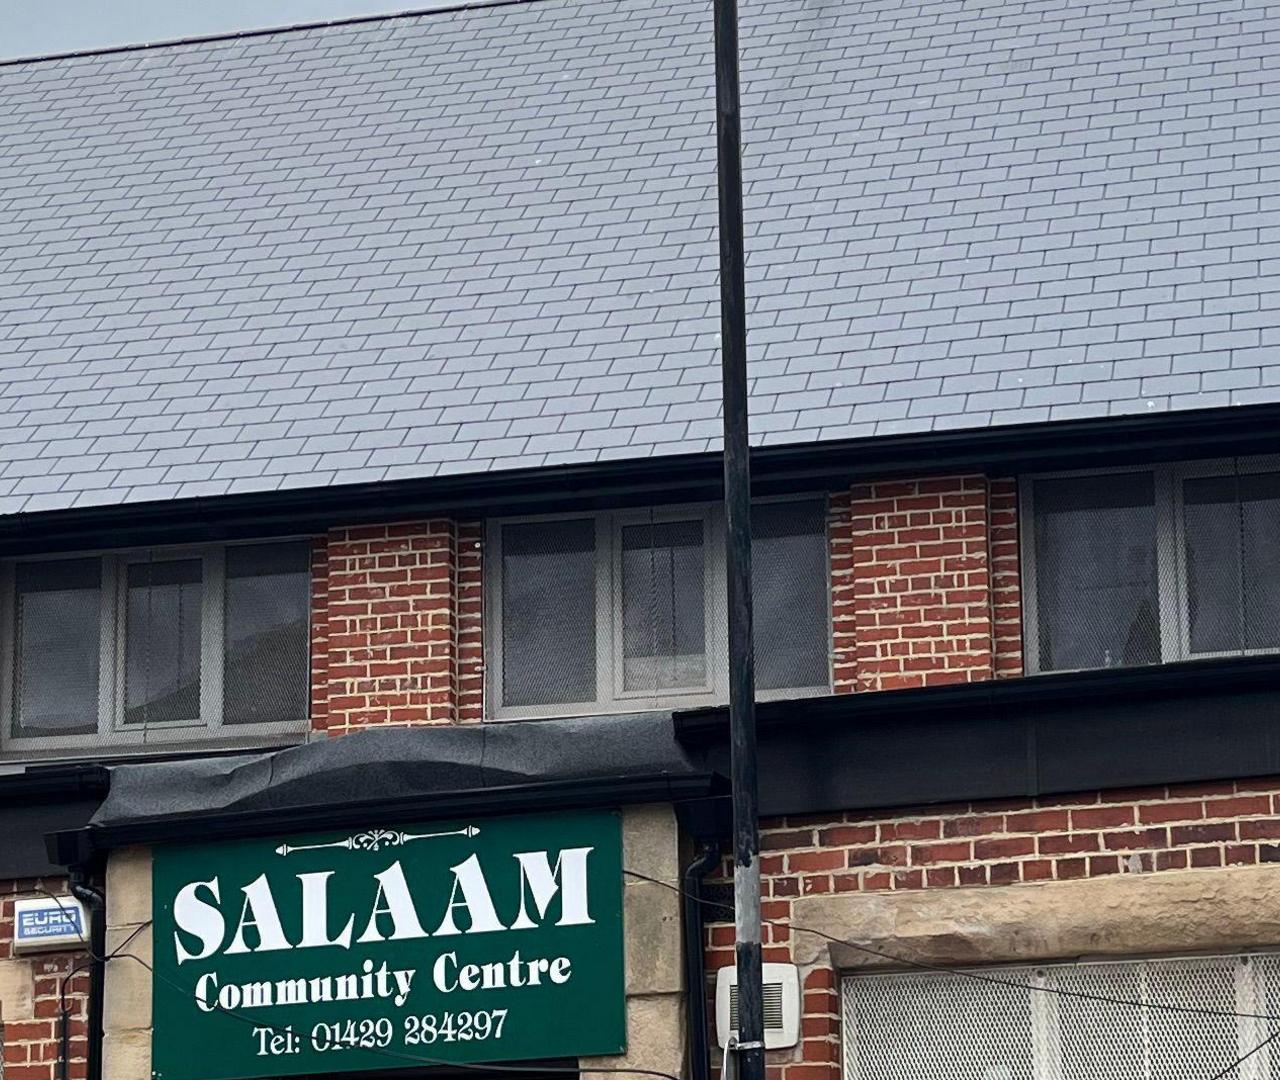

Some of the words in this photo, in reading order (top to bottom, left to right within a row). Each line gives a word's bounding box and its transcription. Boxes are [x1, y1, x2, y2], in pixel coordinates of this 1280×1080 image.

[22, 910, 76, 926] EURO
[173, 846, 596, 966] SALAAM
[24, 925, 75, 935] SECURITY
[195, 959, 416, 1012] Community
[433, 949, 572, 994] Centre
[252, 1026, 301, 1056] Tel:
[311, 1018, 394, 1052] 01429
[404, 1009, 508, 1046] 284297
